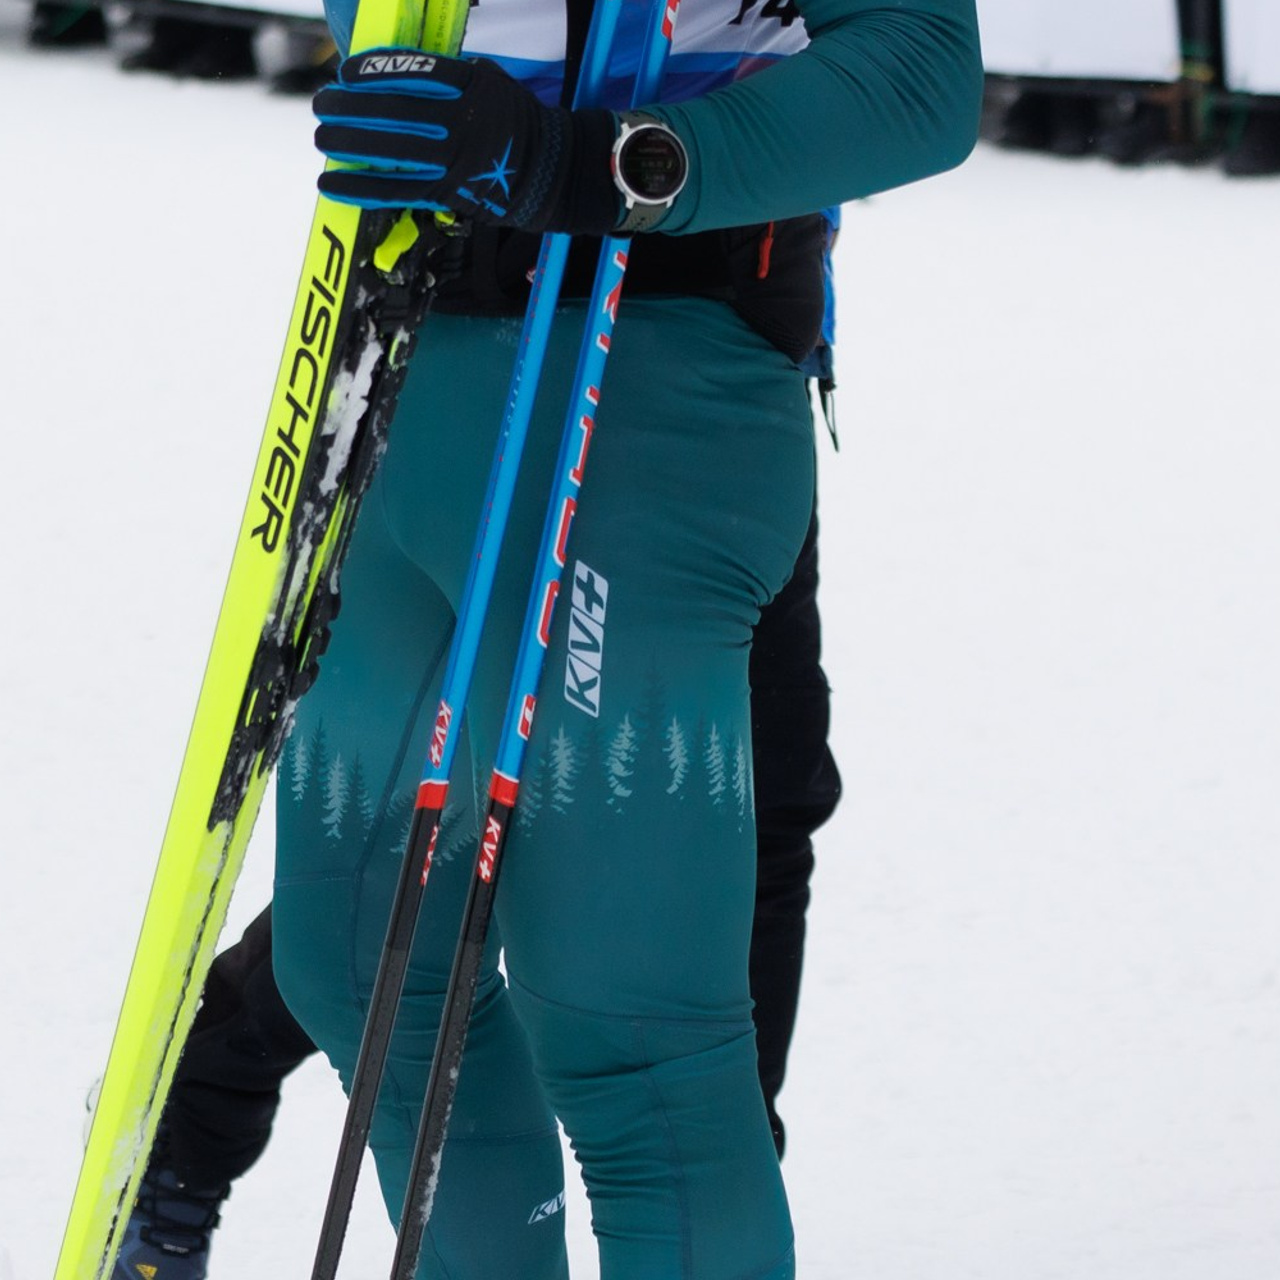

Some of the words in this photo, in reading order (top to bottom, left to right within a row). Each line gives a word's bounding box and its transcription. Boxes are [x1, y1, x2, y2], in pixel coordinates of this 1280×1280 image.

[360, 55, 437, 75] KV+
[250, 224, 347, 555] FISCHER
[564, 560, 608, 718] KV+
[429, 697, 452, 768] KV+
[476, 815, 502, 882] KV+
